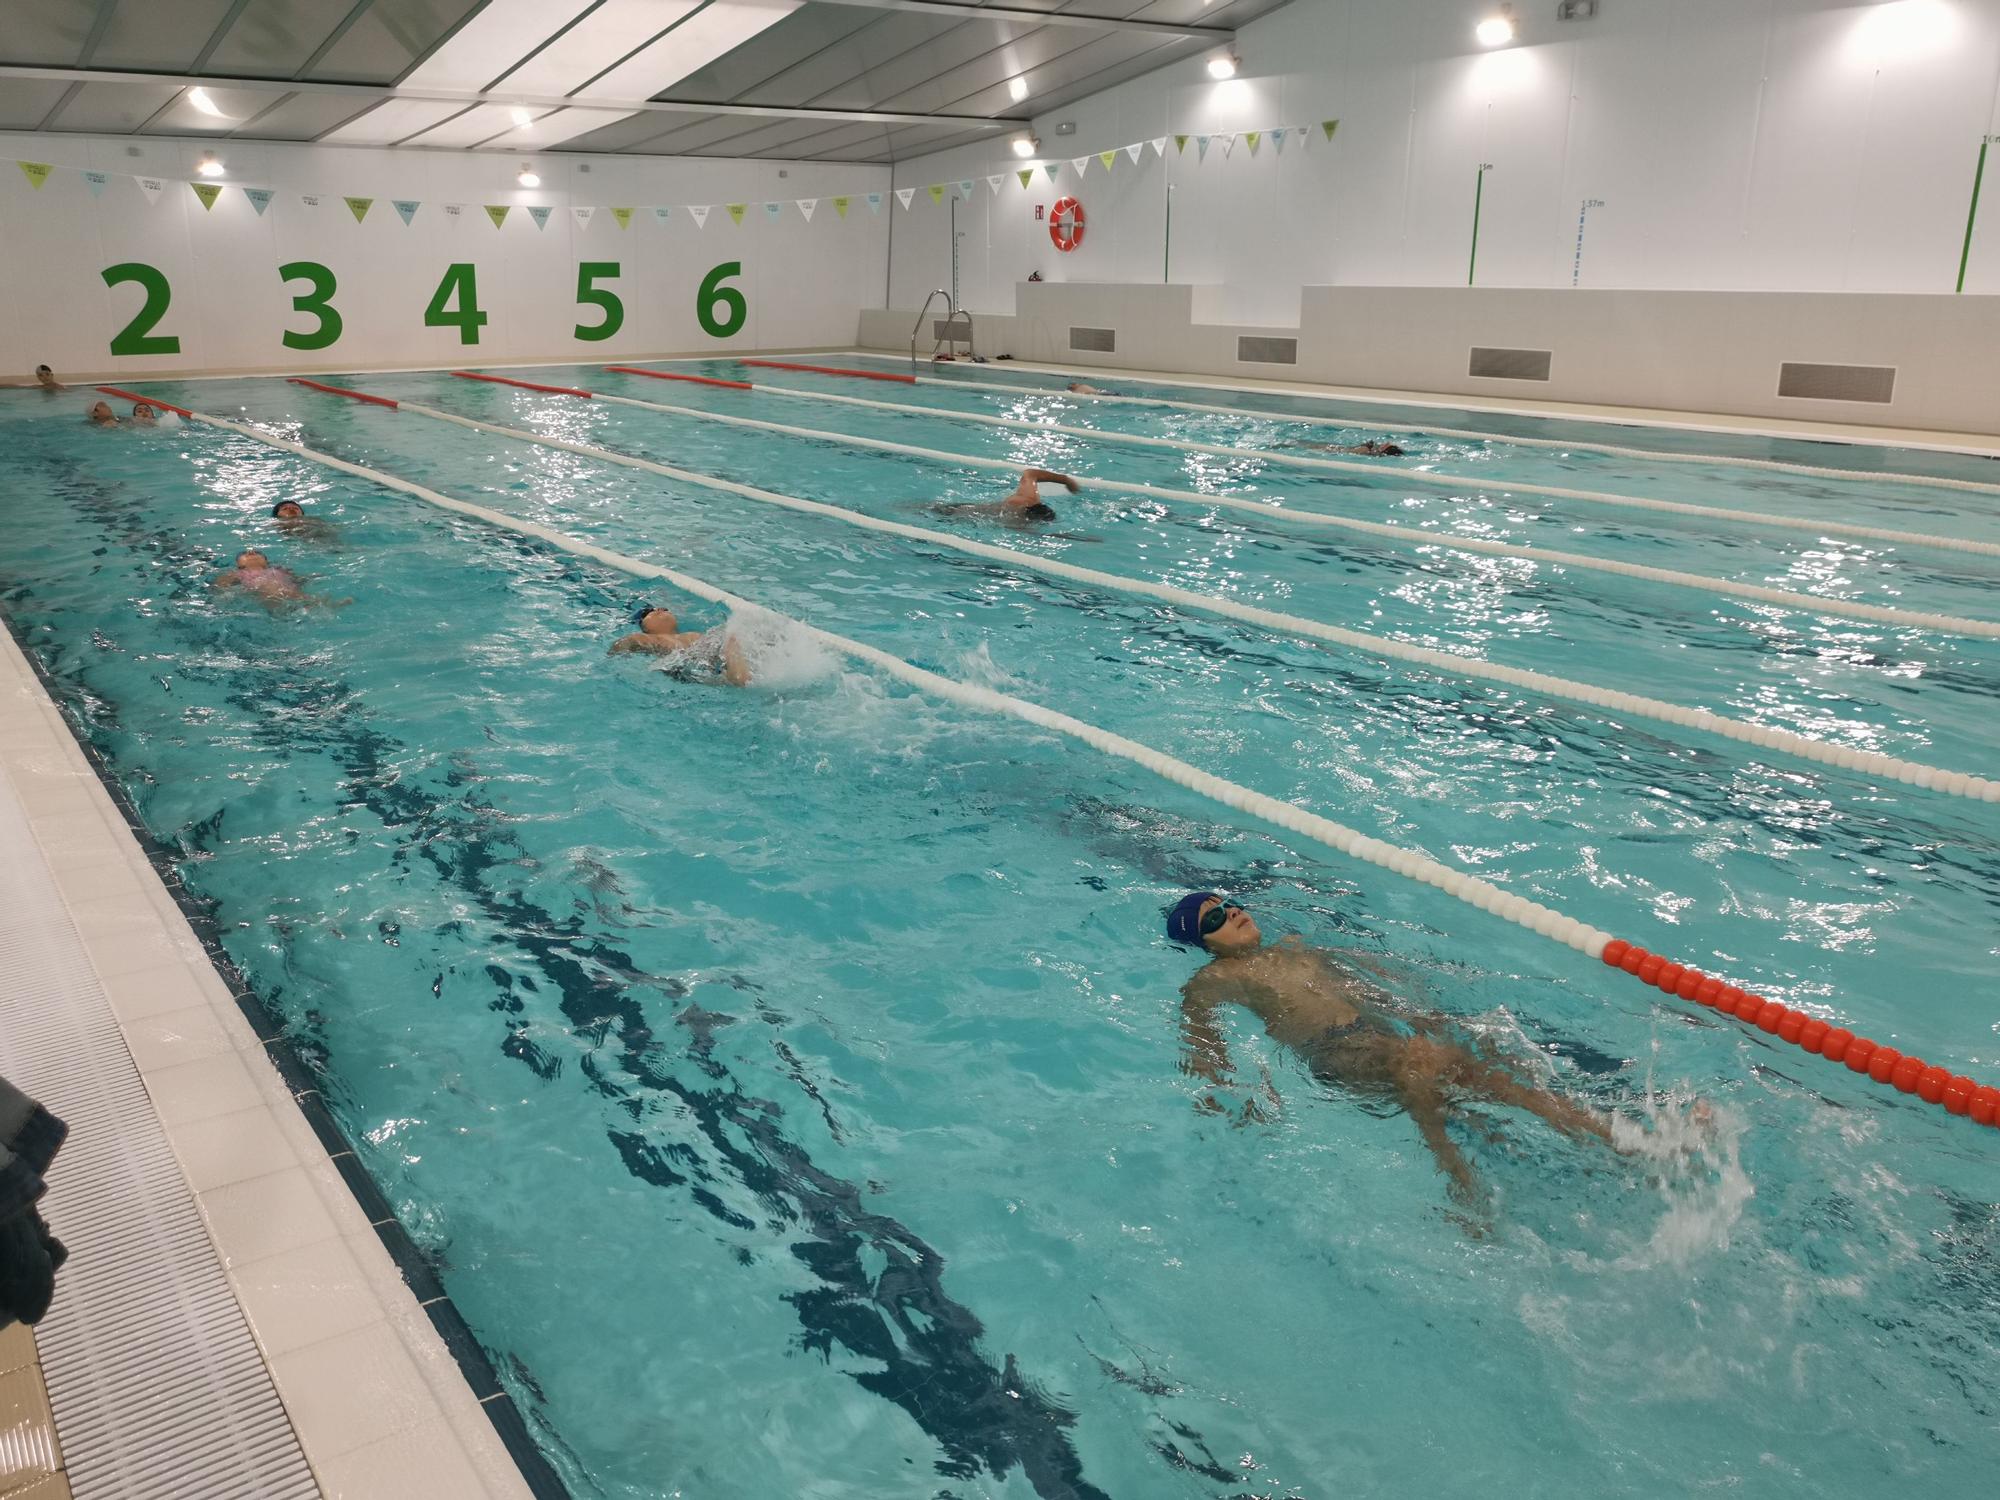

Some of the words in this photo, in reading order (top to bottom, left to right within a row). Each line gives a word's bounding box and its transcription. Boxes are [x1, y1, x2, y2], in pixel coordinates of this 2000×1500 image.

[102, 263, 181, 355] 2
[278, 261, 343, 350] 3
[424, 263, 487, 344] 4
[574, 263, 624, 341] 5
[697, 262, 747, 337] 6
